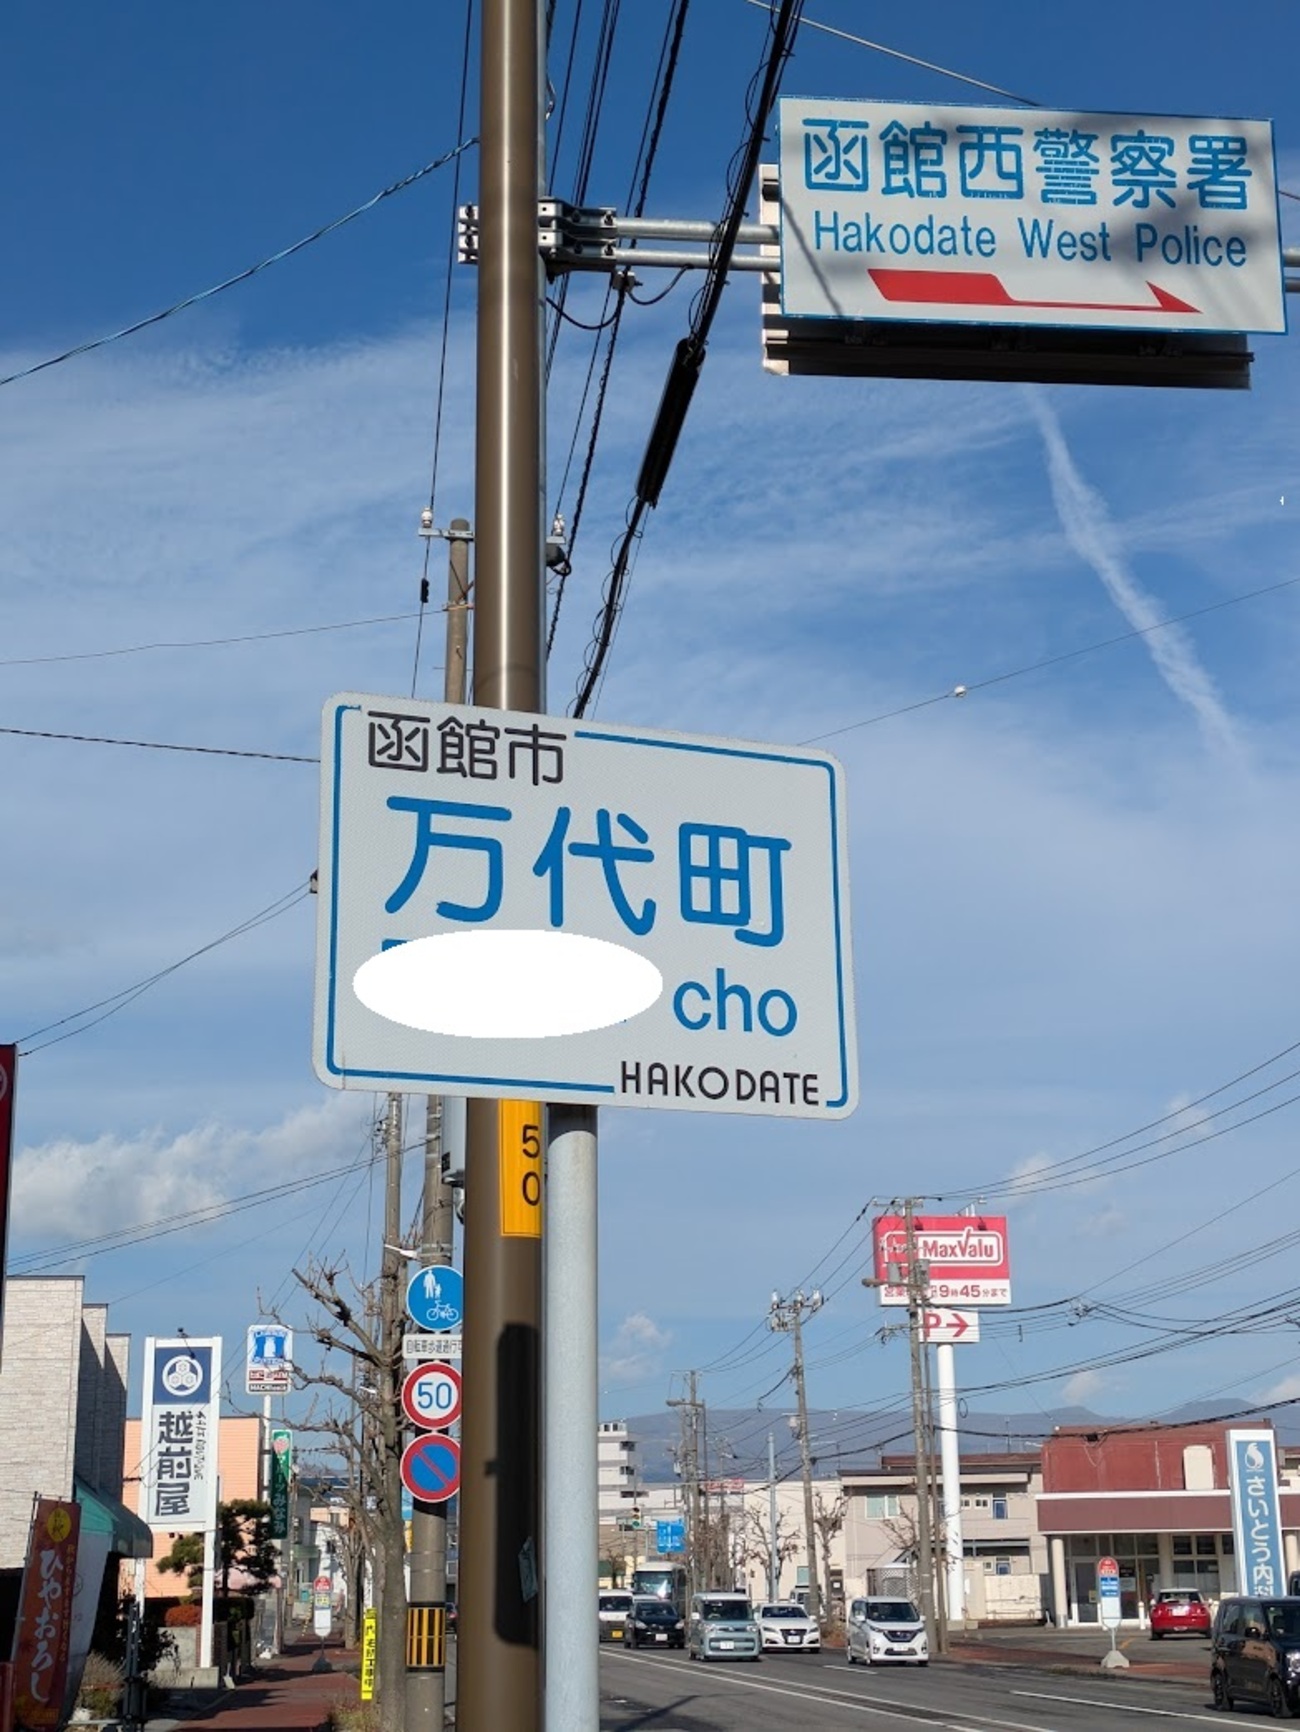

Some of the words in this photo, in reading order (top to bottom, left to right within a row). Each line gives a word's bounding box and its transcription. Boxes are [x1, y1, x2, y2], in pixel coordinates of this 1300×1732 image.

[802, 118, 1253, 210] 函館西警察署
[814, 210, 996, 258] Hakodate
[1017, 217, 1112, 262] West
[1136, 222, 1247, 267] Police
[367, 710, 567, 786] 函館市
[384, 795, 792, 947] 万代町
[673, 967, 798, 1037] cho
[620, 1060, 819, 1106] HAKODATE
[922, 1229, 994, 1258] MaxValu
[924, 1312, 942, 1338] P
[417, 1382, 452, 1410] 50
[154, 1411, 194, 1516] 越前屋
[30, 1549, 64, 1701] ひやおろし
